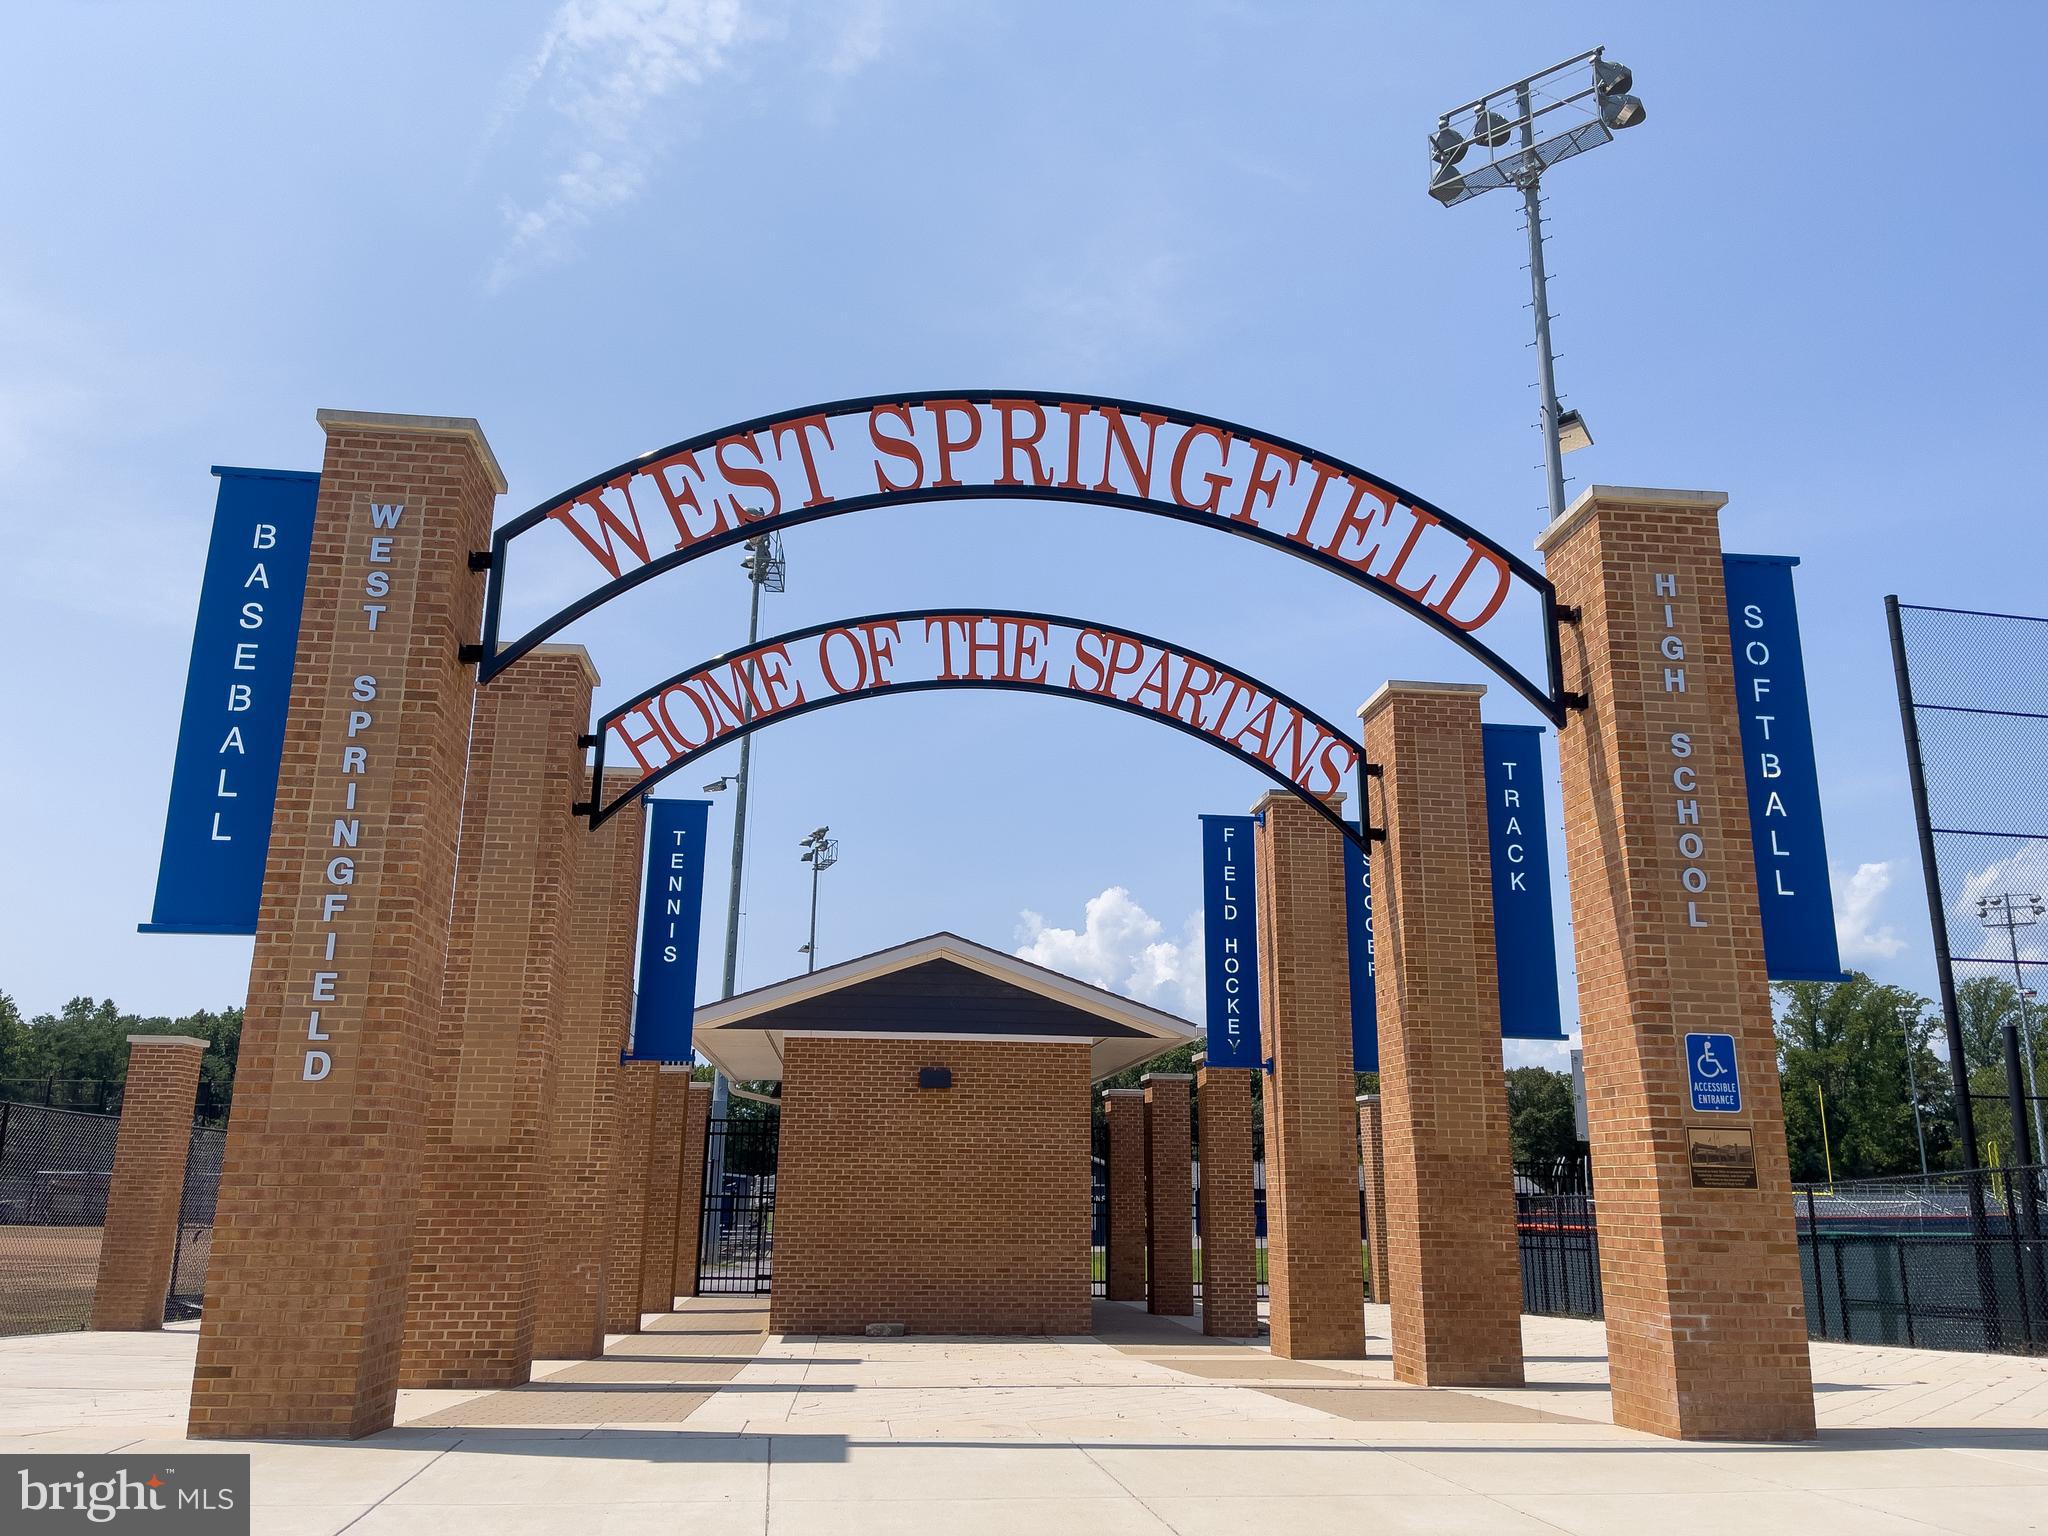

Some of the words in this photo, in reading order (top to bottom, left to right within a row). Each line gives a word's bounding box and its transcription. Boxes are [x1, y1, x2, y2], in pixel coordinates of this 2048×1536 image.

[363, 503, 405, 631] WEST
[546, 413, 835, 581] WEST
[868, 399, 1511, 632] SPRINGFIELD
[211, 524, 277, 841] BASEBALL
[605, 643, 805, 780] HOME
[819, 619, 901, 694] OF
[924, 615, 1049, 684] THE
[1068, 627, 1361, 800] SPARTANS
[1655, 573, 1686, 693] HIGH
[1671, 732, 1708, 928] SCHOOL
[1744, 605, 1795, 896] SOFTBALL
[302, 676, 377, 1081] SPRINGFIELD
[1223, 828, 1238, 920] FIELD
[1502, 762, 1526, 891] TRACK
[663, 830, 686, 962] TENNIS
[1224, 938, 1241, 1055] HOCKEY
[1694, 1082, 1736, 1093] ACCESSIBLE
[1698, 1094, 1735, 1105] ENTRANCE
